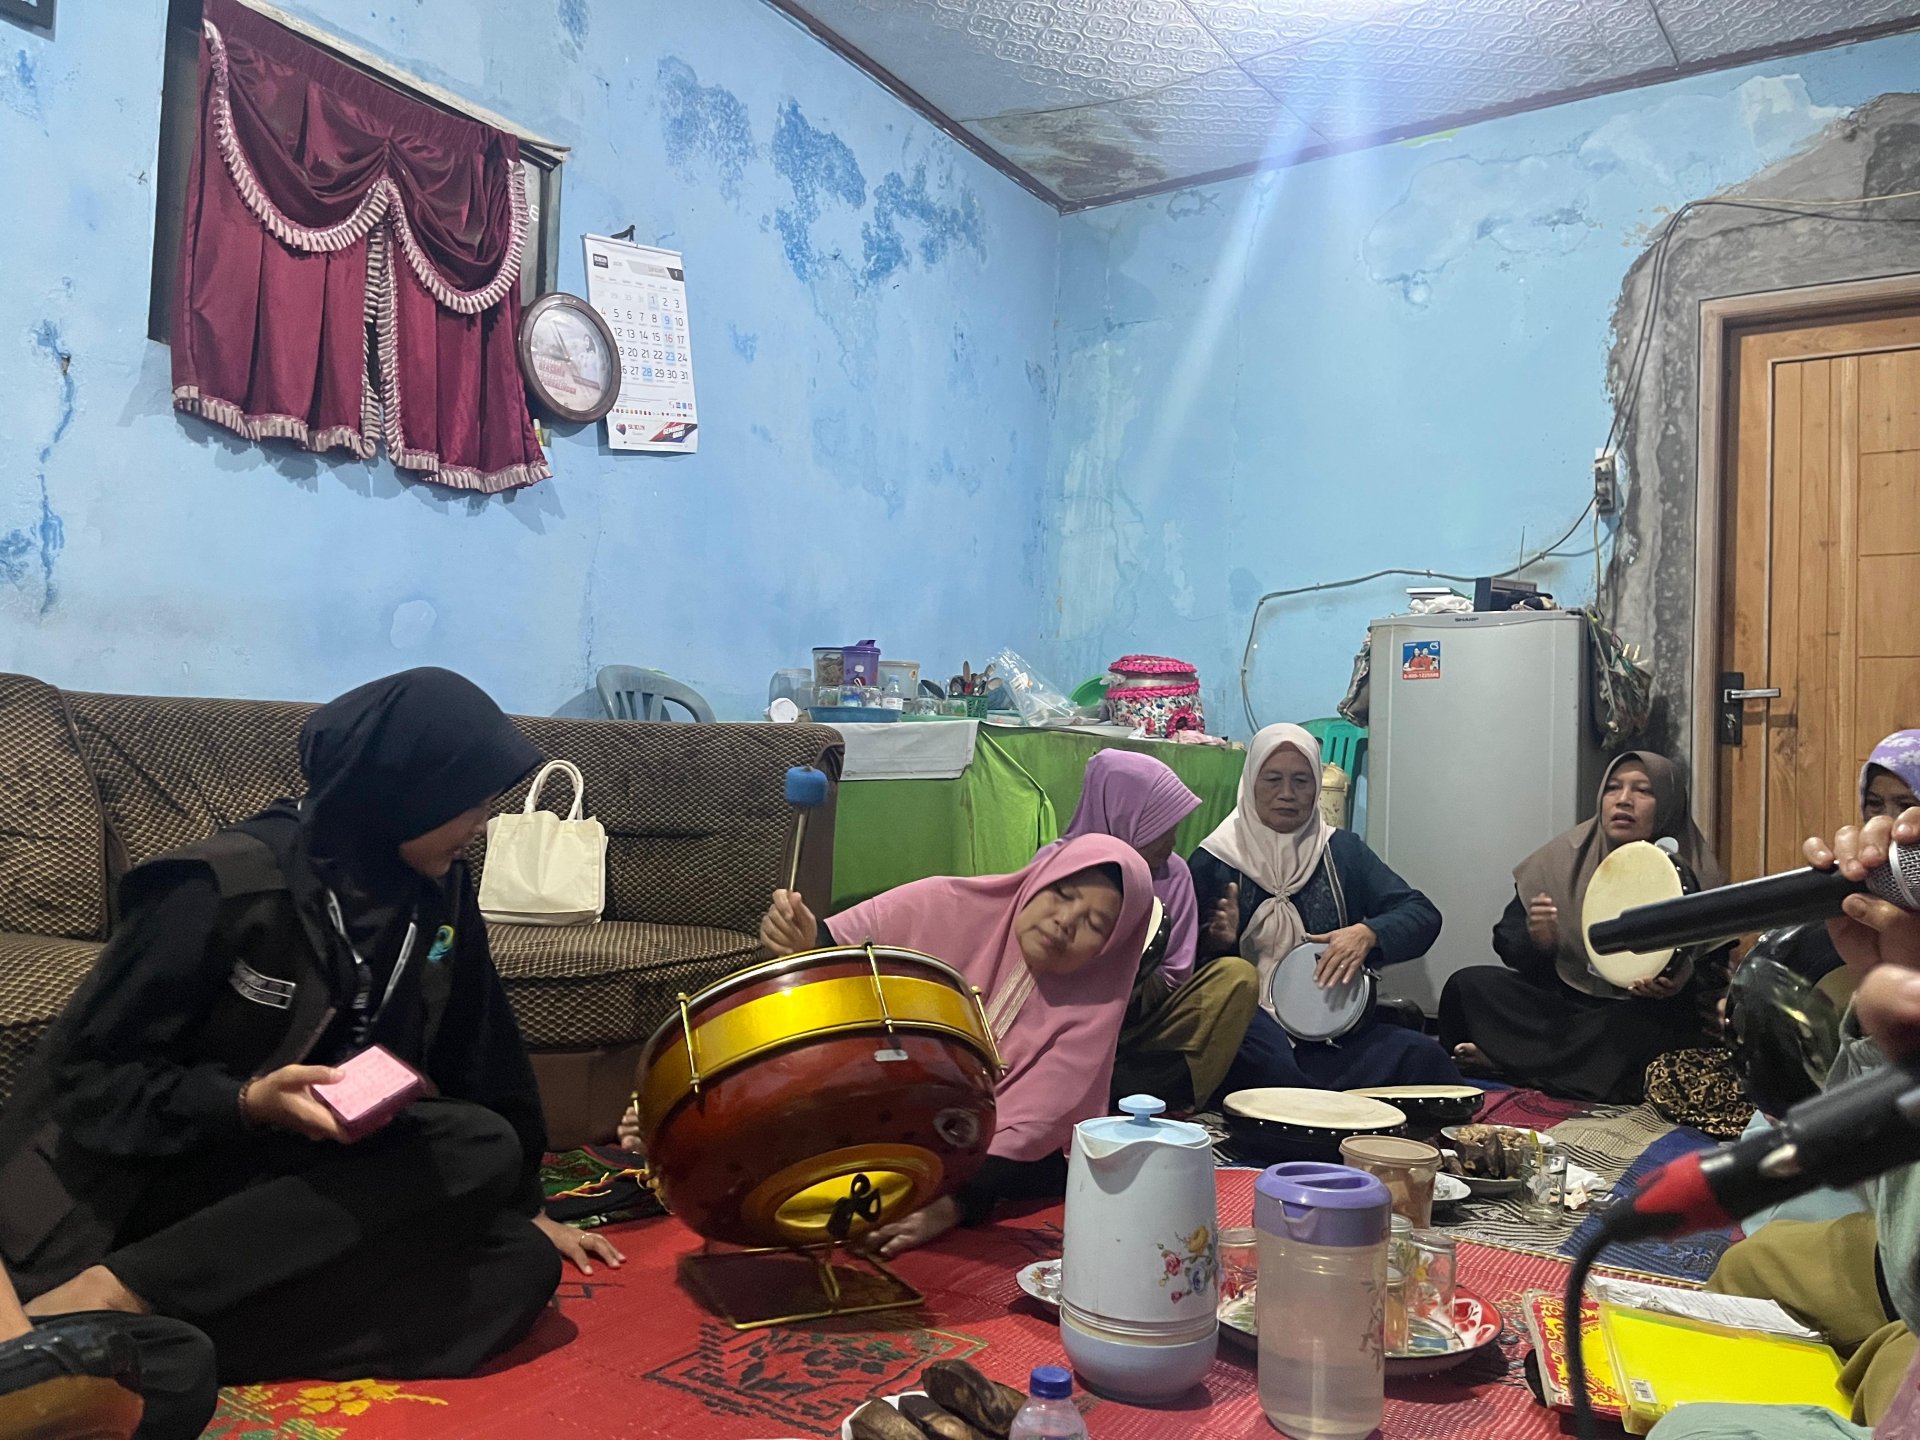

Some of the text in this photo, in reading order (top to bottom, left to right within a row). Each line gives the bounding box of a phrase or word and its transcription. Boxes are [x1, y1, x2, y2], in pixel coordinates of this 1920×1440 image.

[662, 297, 668, 306] 2
[674, 299, 680, 308] 3
[613, 308, 619, 317] 5
[627, 310, 632, 319] 6
[639, 312, 644, 321] 7
[651, 314, 657, 323] 8
[664, 315, 670, 325] 9
[674, 317, 683, 326] 10
[614, 327, 684, 344] 12 13 14 15 16 17
[617, 346, 687, 362] 9 20 21 22 23 24
[630, 367, 639, 376] 27
[642, 367, 652, 377] 28
[655, 368, 665, 378] 29
[667, 369, 677, 379] 30
[680, 371, 688, 380] 31
